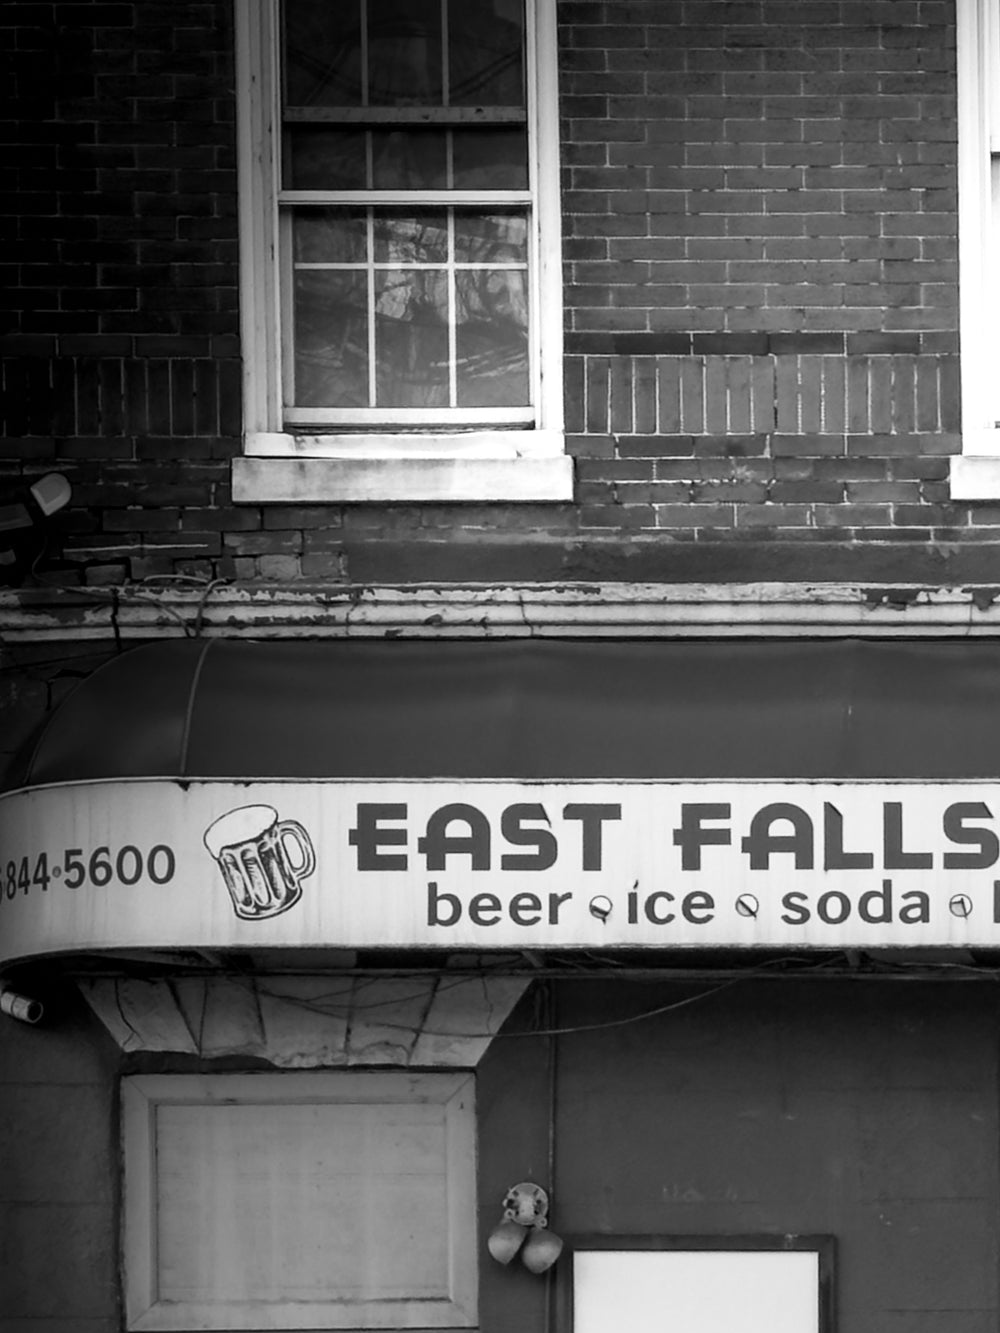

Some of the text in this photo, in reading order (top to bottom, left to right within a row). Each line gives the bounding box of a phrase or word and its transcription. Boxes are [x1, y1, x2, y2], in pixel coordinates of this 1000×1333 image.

[348, 802, 622, 872] EAST
[672, 802, 1000, 872] FALLS
[427, 882, 572, 926] beer
[627, 880, 716, 925] ice
[781, 879, 931, 925] soda
